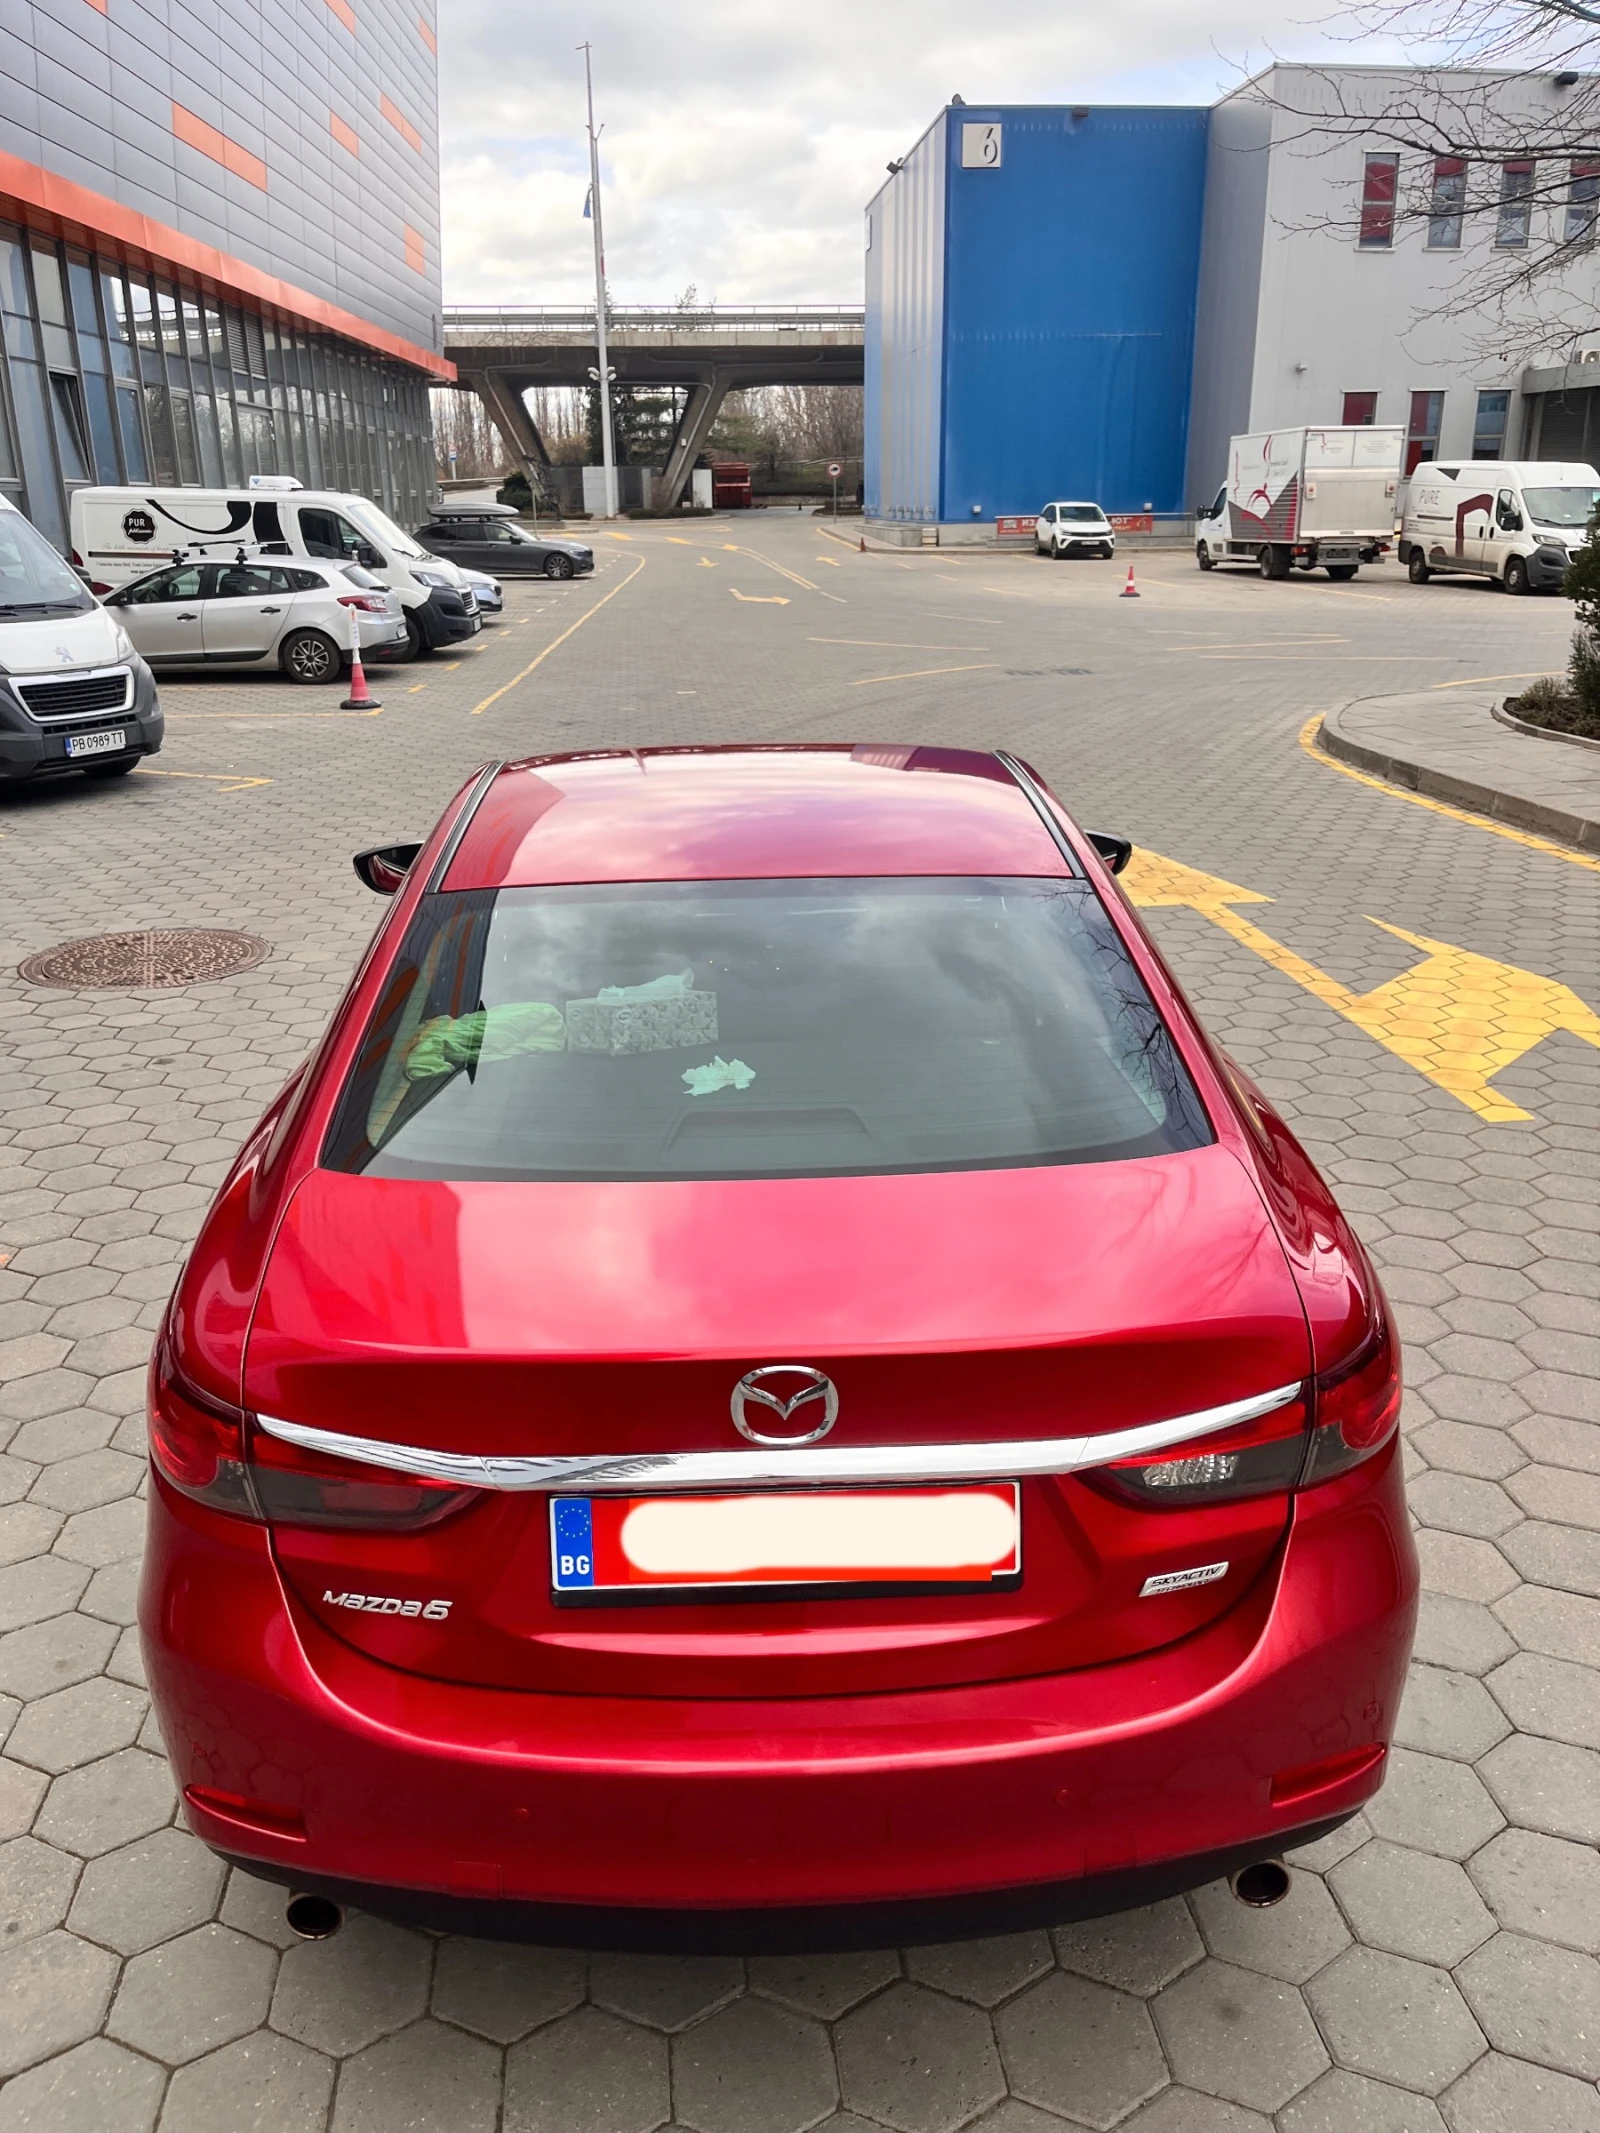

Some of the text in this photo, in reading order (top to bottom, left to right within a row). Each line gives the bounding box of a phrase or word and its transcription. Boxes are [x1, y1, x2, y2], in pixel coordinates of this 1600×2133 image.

[979, 126, 998, 164] 6
[128, 518, 145, 527] PUR
[72, 732, 122, 750] PB 0989 TT
[561, 1555, 590, 1575] BG
[1151, 1566, 1224, 1586] SKYACTIV
